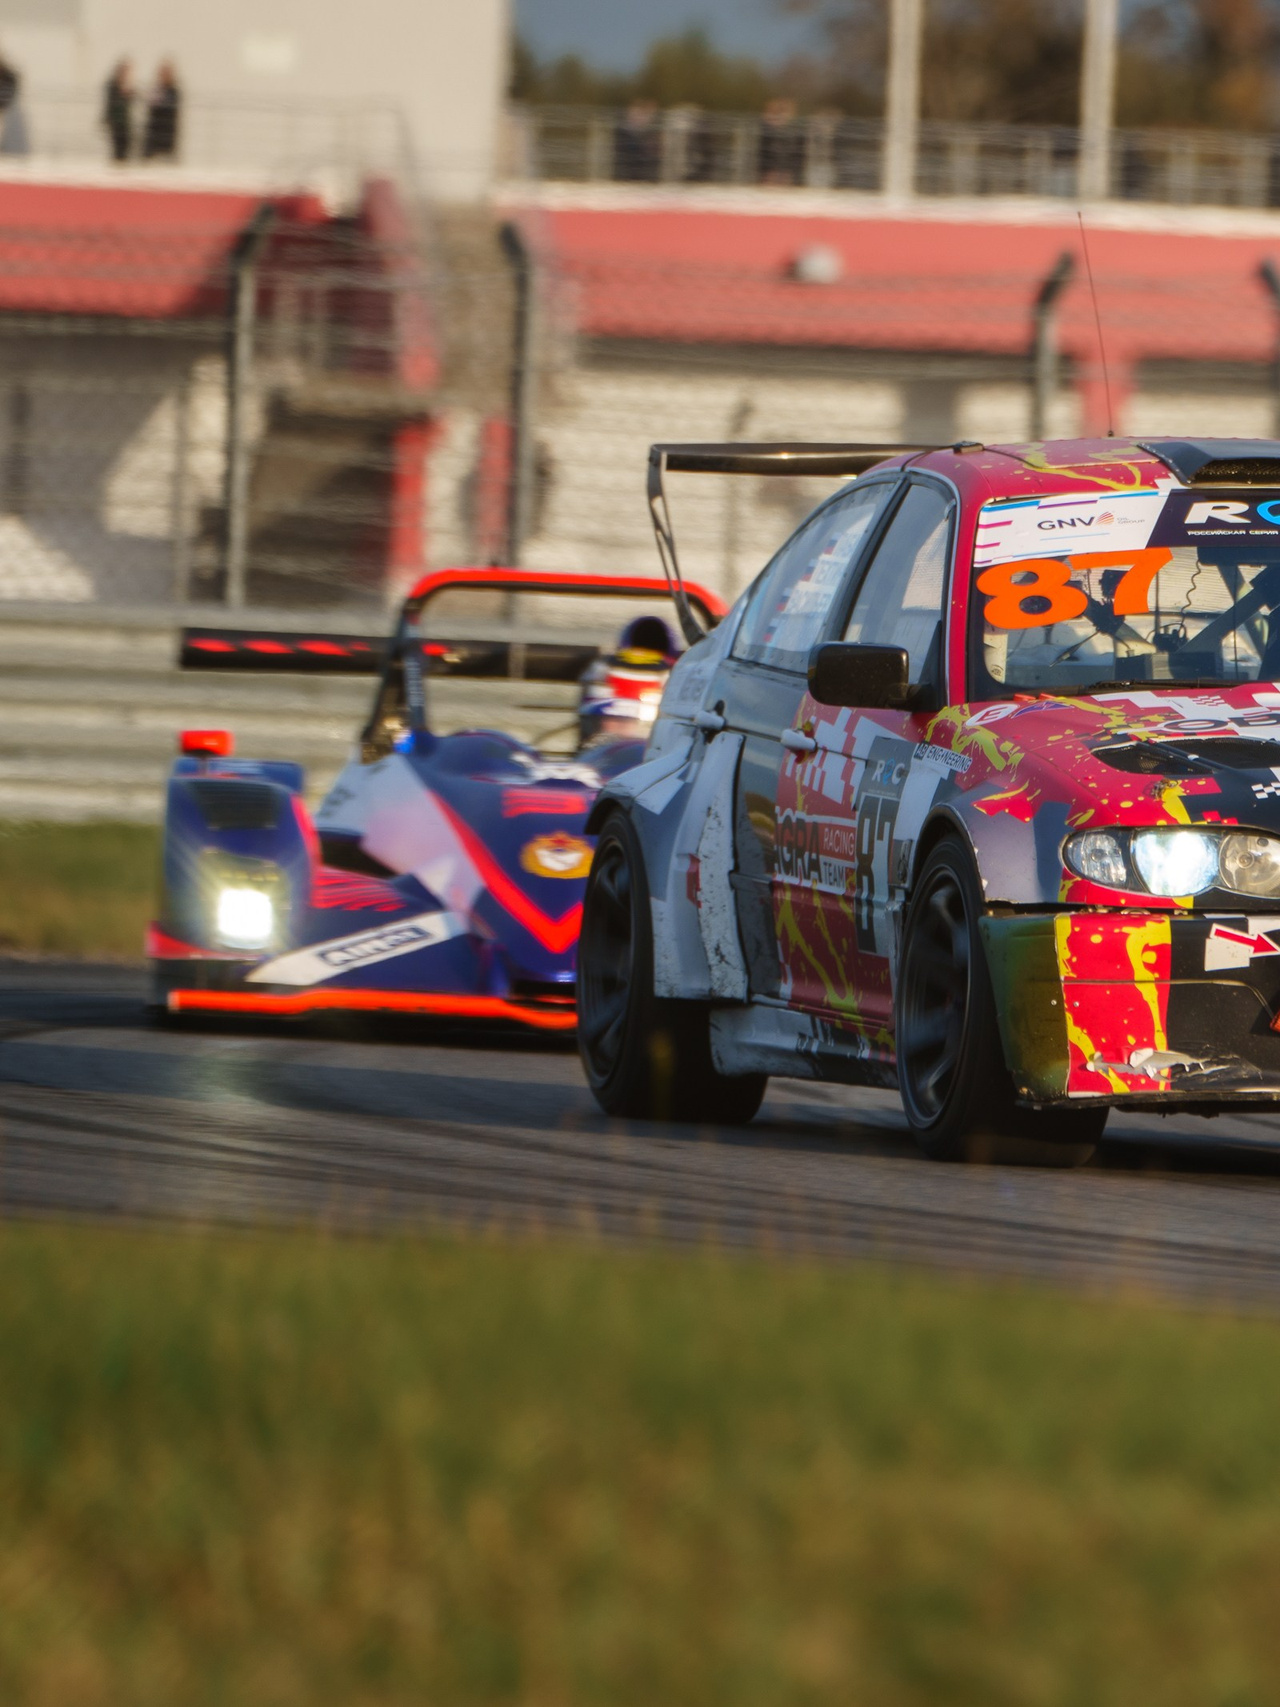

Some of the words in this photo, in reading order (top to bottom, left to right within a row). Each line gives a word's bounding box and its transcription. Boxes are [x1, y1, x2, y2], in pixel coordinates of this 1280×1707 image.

[1037, 516, 1095, 530] GNV
[976, 548, 1172, 629] 87
[823, 829, 856, 855] RACING
[823, 862, 846, 888] TEAM
